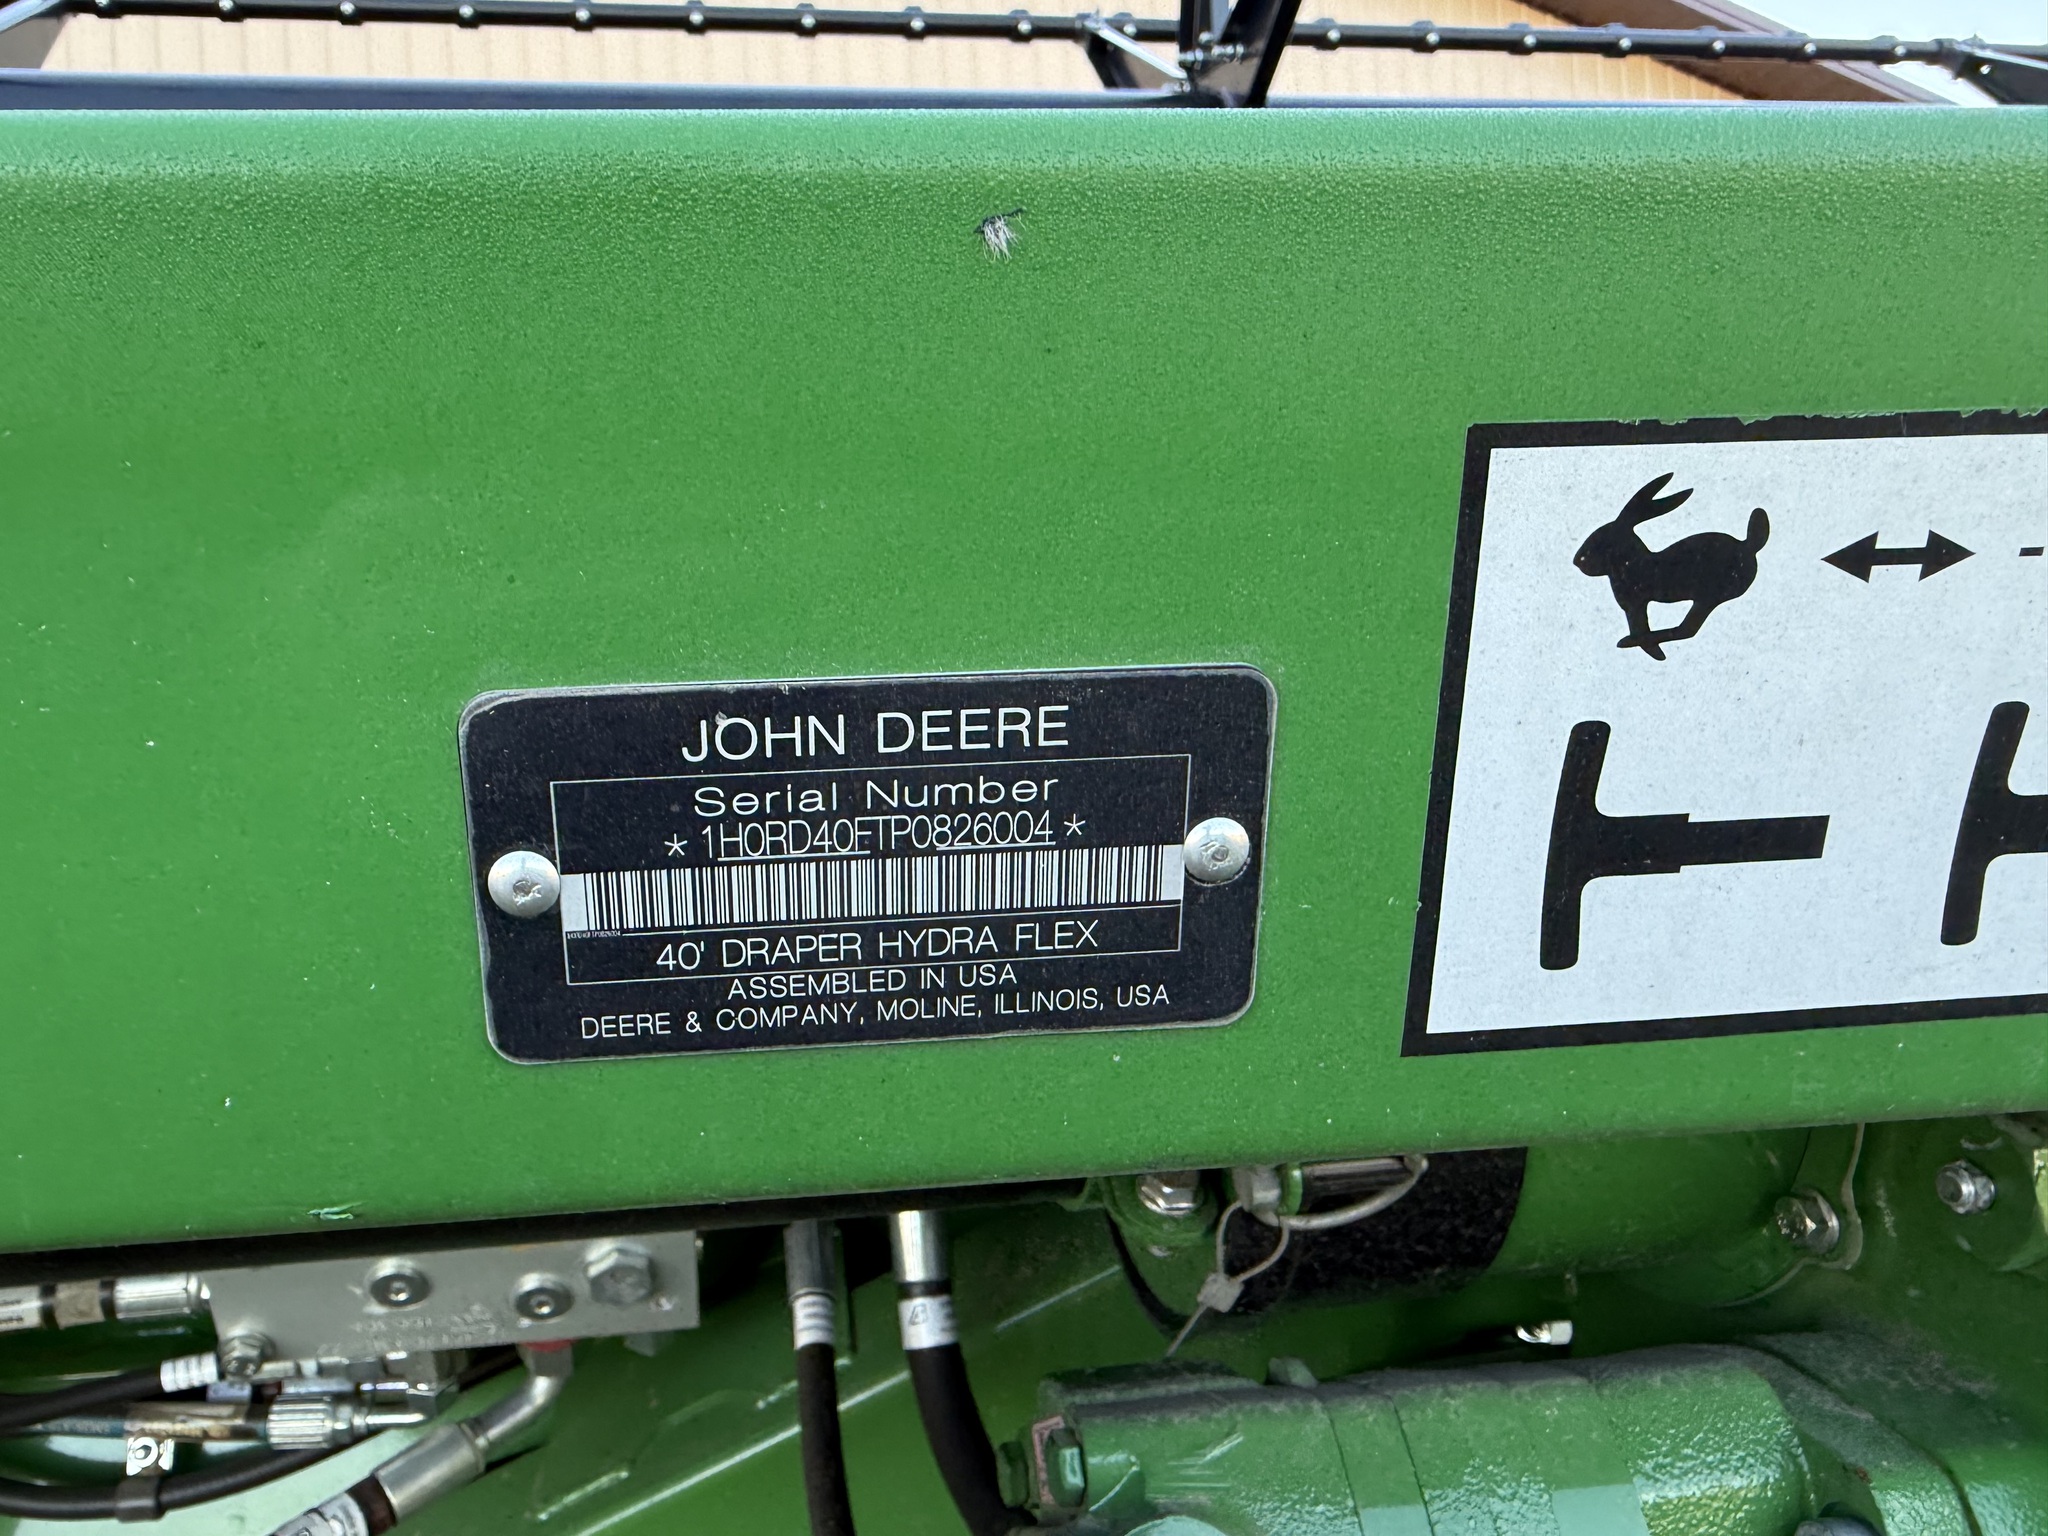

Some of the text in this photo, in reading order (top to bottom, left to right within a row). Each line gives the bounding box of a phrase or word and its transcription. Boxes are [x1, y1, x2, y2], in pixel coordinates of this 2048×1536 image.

[681, 704, 1070, 763] JOHN DEERE
[694, 775, 1060, 818] Serial Number
[701, 809, 1055, 859] 1H0RD40FTP0826004
[656, 919, 1099, 971] 40' DRAPER HYDRA FLEX
[727, 962, 1018, 1000] ASSEMBLED IN USA
[581, 984, 1170, 1040] DEERE & COMPANY, MOLINE, ILLINOIS, USA
